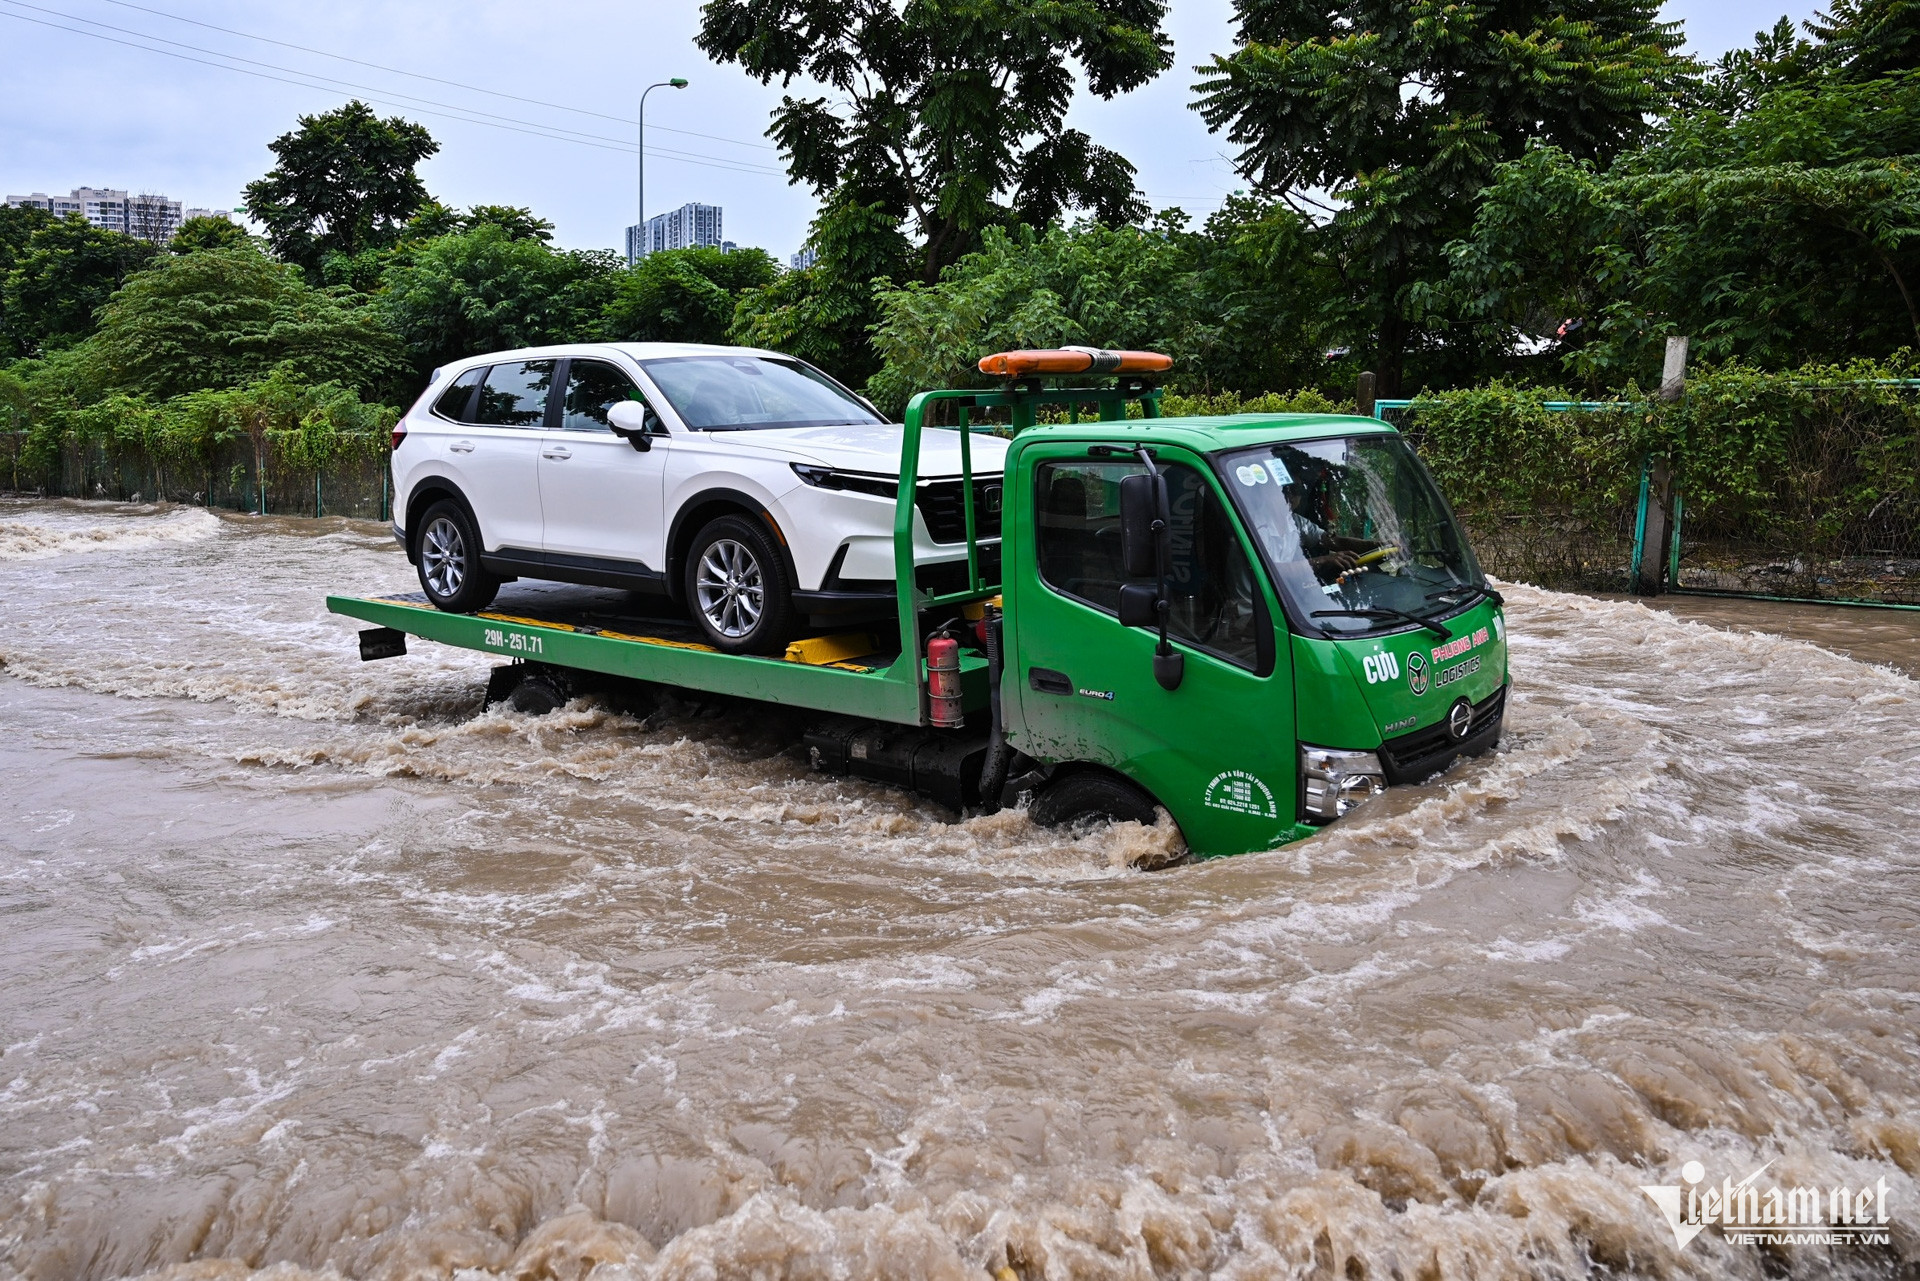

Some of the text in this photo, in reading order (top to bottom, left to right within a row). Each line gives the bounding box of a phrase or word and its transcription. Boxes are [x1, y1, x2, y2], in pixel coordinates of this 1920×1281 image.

[1471, 626, 1490, 648] ANH
[1363, 645, 1399, 684] CỨU
[1435, 655, 1480, 688] LOGISTICS
[1385, 716, 1416, 733] HINO
[1218, 772, 1227, 780] TM
[1232, 769, 1244, 778] VẬN
[1268, 801, 1277, 813] ANH
